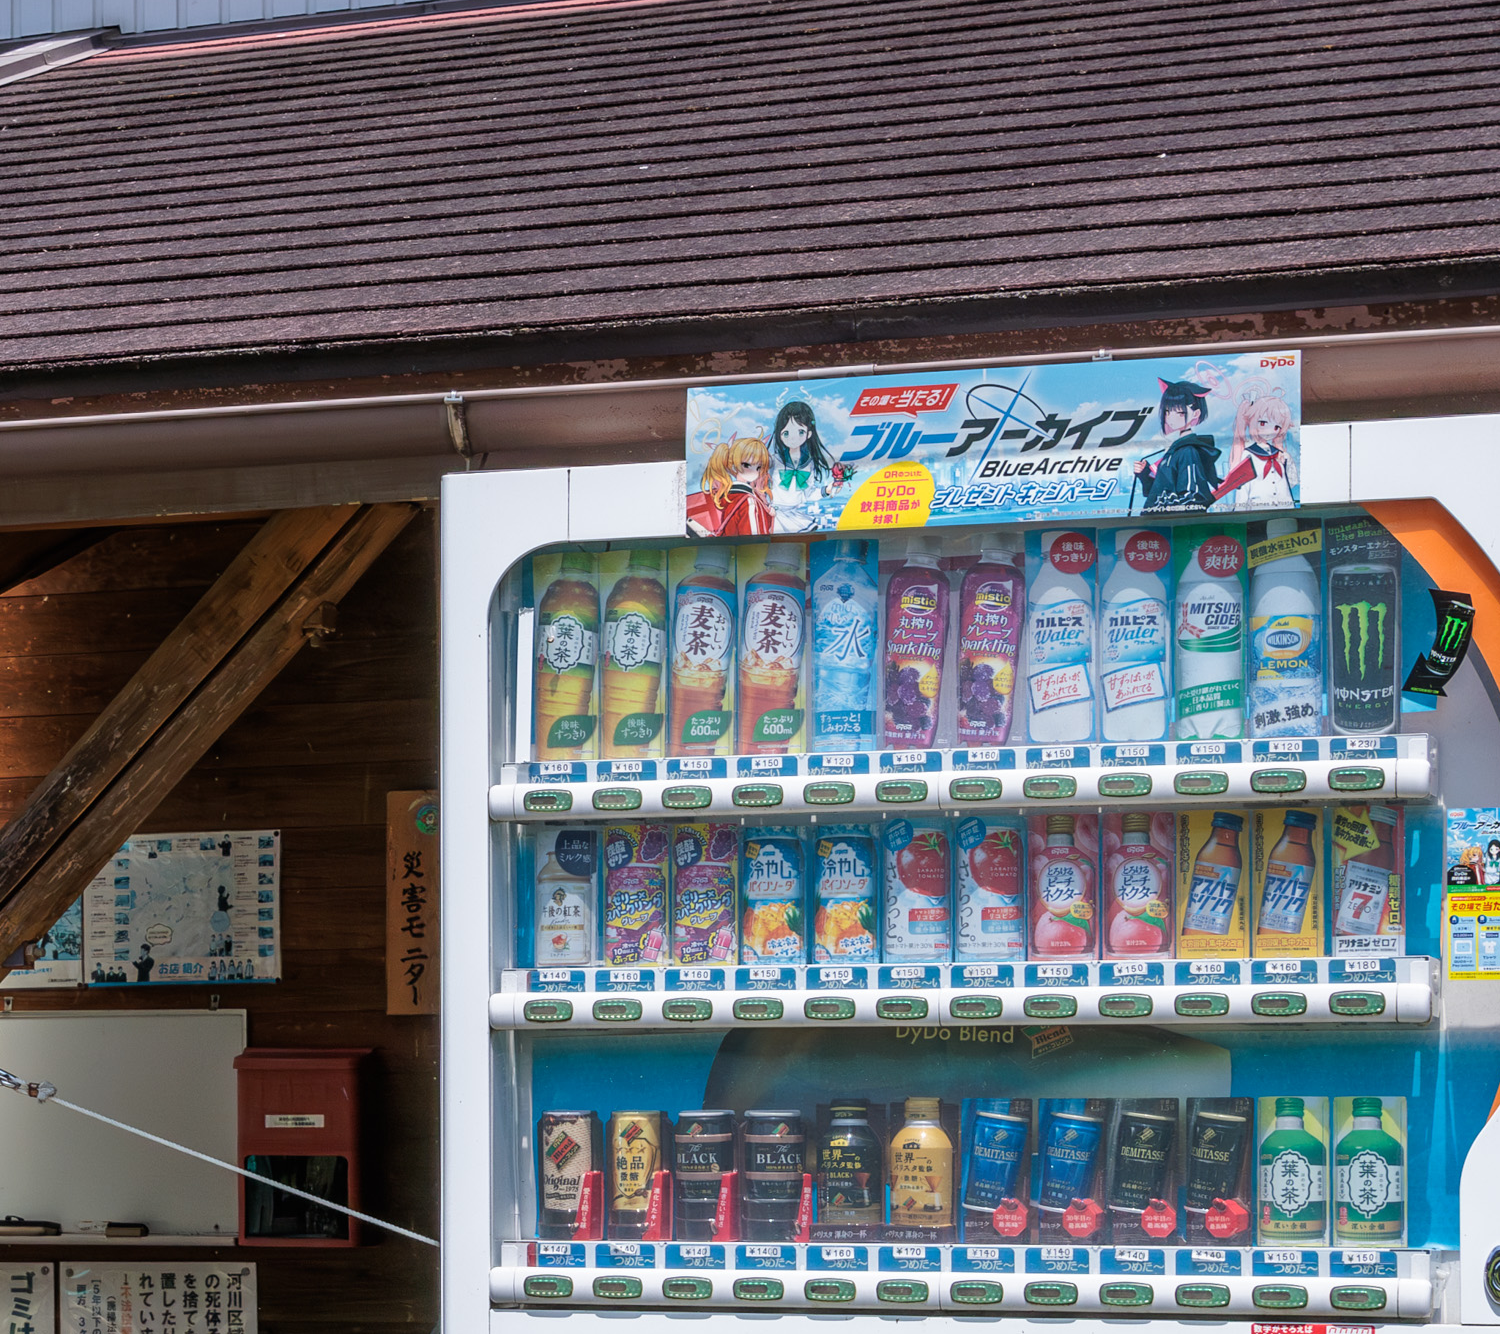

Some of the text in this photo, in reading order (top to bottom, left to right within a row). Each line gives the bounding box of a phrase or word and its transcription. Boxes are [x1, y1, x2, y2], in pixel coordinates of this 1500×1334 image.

[1260, 355, 1295, 369] DyDo
[839, 406, 1154, 462] ブルーアーカイブ
[979, 456, 1122, 478] BlueArchive
[876, 486, 915, 498] DyDo
[930, 479, 1117, 509] プレゼント キャンペーン
[860, 500, 920, 513] 飲料商品が
[1061, 542, 1085, 552] 後味
[1136, 540, 1160, 550] 後味
[1204, 544, 1238, 554] スッキリ
[1329, 541, 1397, 556] モンスターエナジー
[1203, 555, 1238, 570] 爽快
[1189, 602, 1241, 614] MITSUYA
[898, 616, 934, 629] 丸搾り
[973, 612, 1008, 626] 丸搾り
[1035, 617, 1084, 629] カルピス
[1109, 616, 1159, 628] カルピス
[1204, 613, 1241, 626] CIDER
[686, 605, 715, 656] 麦茶
[711, 613, 726, 650] おいしい
[756, 603, 786, 653] 麦茶
[782, 612, 797, 649] おいしい
[892, 626, 939, 640] グレープ
[966, 624, 1014, 638] グレープ
[1107, 626, 1159, 644] Water
[553, 623, 575, 664] 葉の茶
[620, 620, 644, 661] 葉の茶
[824, 618, 871, 662] 水
[1034, 628, 1085, 645] Water
[1266, 632, 1300, 646] WILKINSON
[887, 640, 942, 660] Sparkling
[960, 636, 1016, 657] Sparkling
[1260, 660, 1309, 670] LEMON
[1338, 701, 1389, 709] ENERGY
[691, 717, 721, 725] たっぷり
[820, 723, 861, 733] しみわたる
[554, 730, 586, 740] すっきり
[621, 728, 653, 738] すっきり
[690, 725, 720, 736] 600ml
[762, 724, 793, 735] 600ml
[750, 860, 792, 880] 冷やし
[822, 859, 865, 879] 冷やし
[1047, 867, 1074, 877] とろける
[1123, 865, 1150, 876] とろける
[1048, 876, 1074, 888] ピーチ
[1123, 875, 1150, 887] ピーチ
[1042, 887, 1082, 902] ネクター
[1118, 886, 1158, 901] ネクター
[1350, 891, 1374, 919] 7
[400, 851, 429, 1005] 災害モニター
[1338, 939, 1371, 948] アリナミン
[960, 1026, 1014, 1043] Blend
[677, 1152, 717, 1164] BLACK
[822, 1148, 861, 1162] 世界一の
[894, 1152, 932, 1164] 世界一の
[616, 1157, 645, 1170] 絶品
[620, 1172, 639, 1182] 微糖
[1281, 1159, 1300, 1205] 葉の茶
[1358, 1160, 1378, 1206] 葉の茶
[1253, 1325, 1313, 1334] 数字がそろえば
